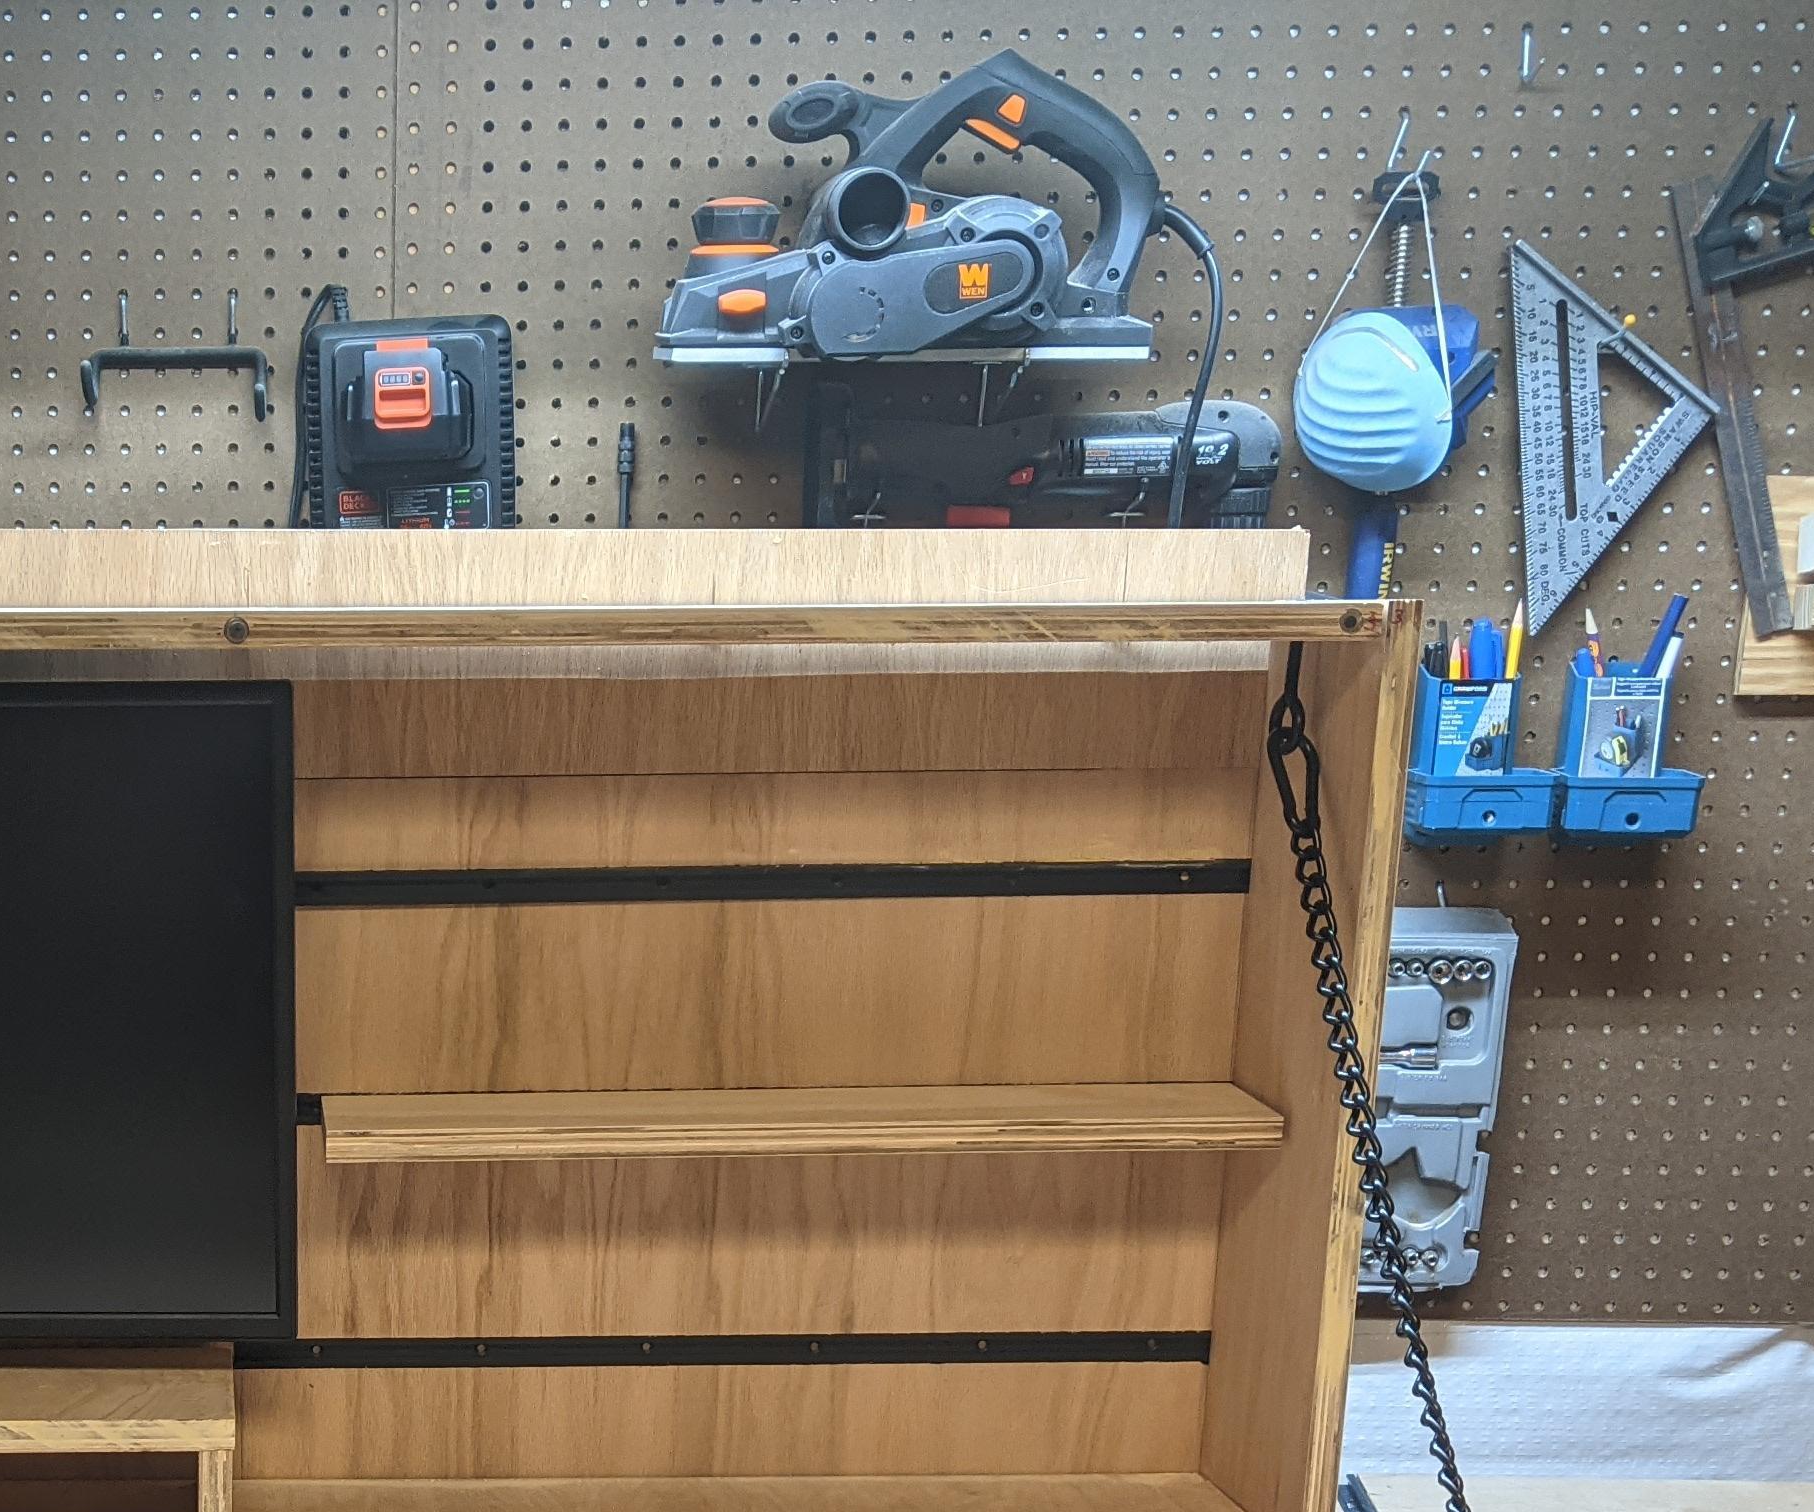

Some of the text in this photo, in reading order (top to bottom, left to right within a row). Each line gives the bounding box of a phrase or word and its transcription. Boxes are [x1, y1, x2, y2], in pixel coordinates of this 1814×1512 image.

[962, 287, 985, 295] WEN
[1646, 412, 1690, 464] SWANSON
[1580, 503, 1590, 556] TOP CUTS
